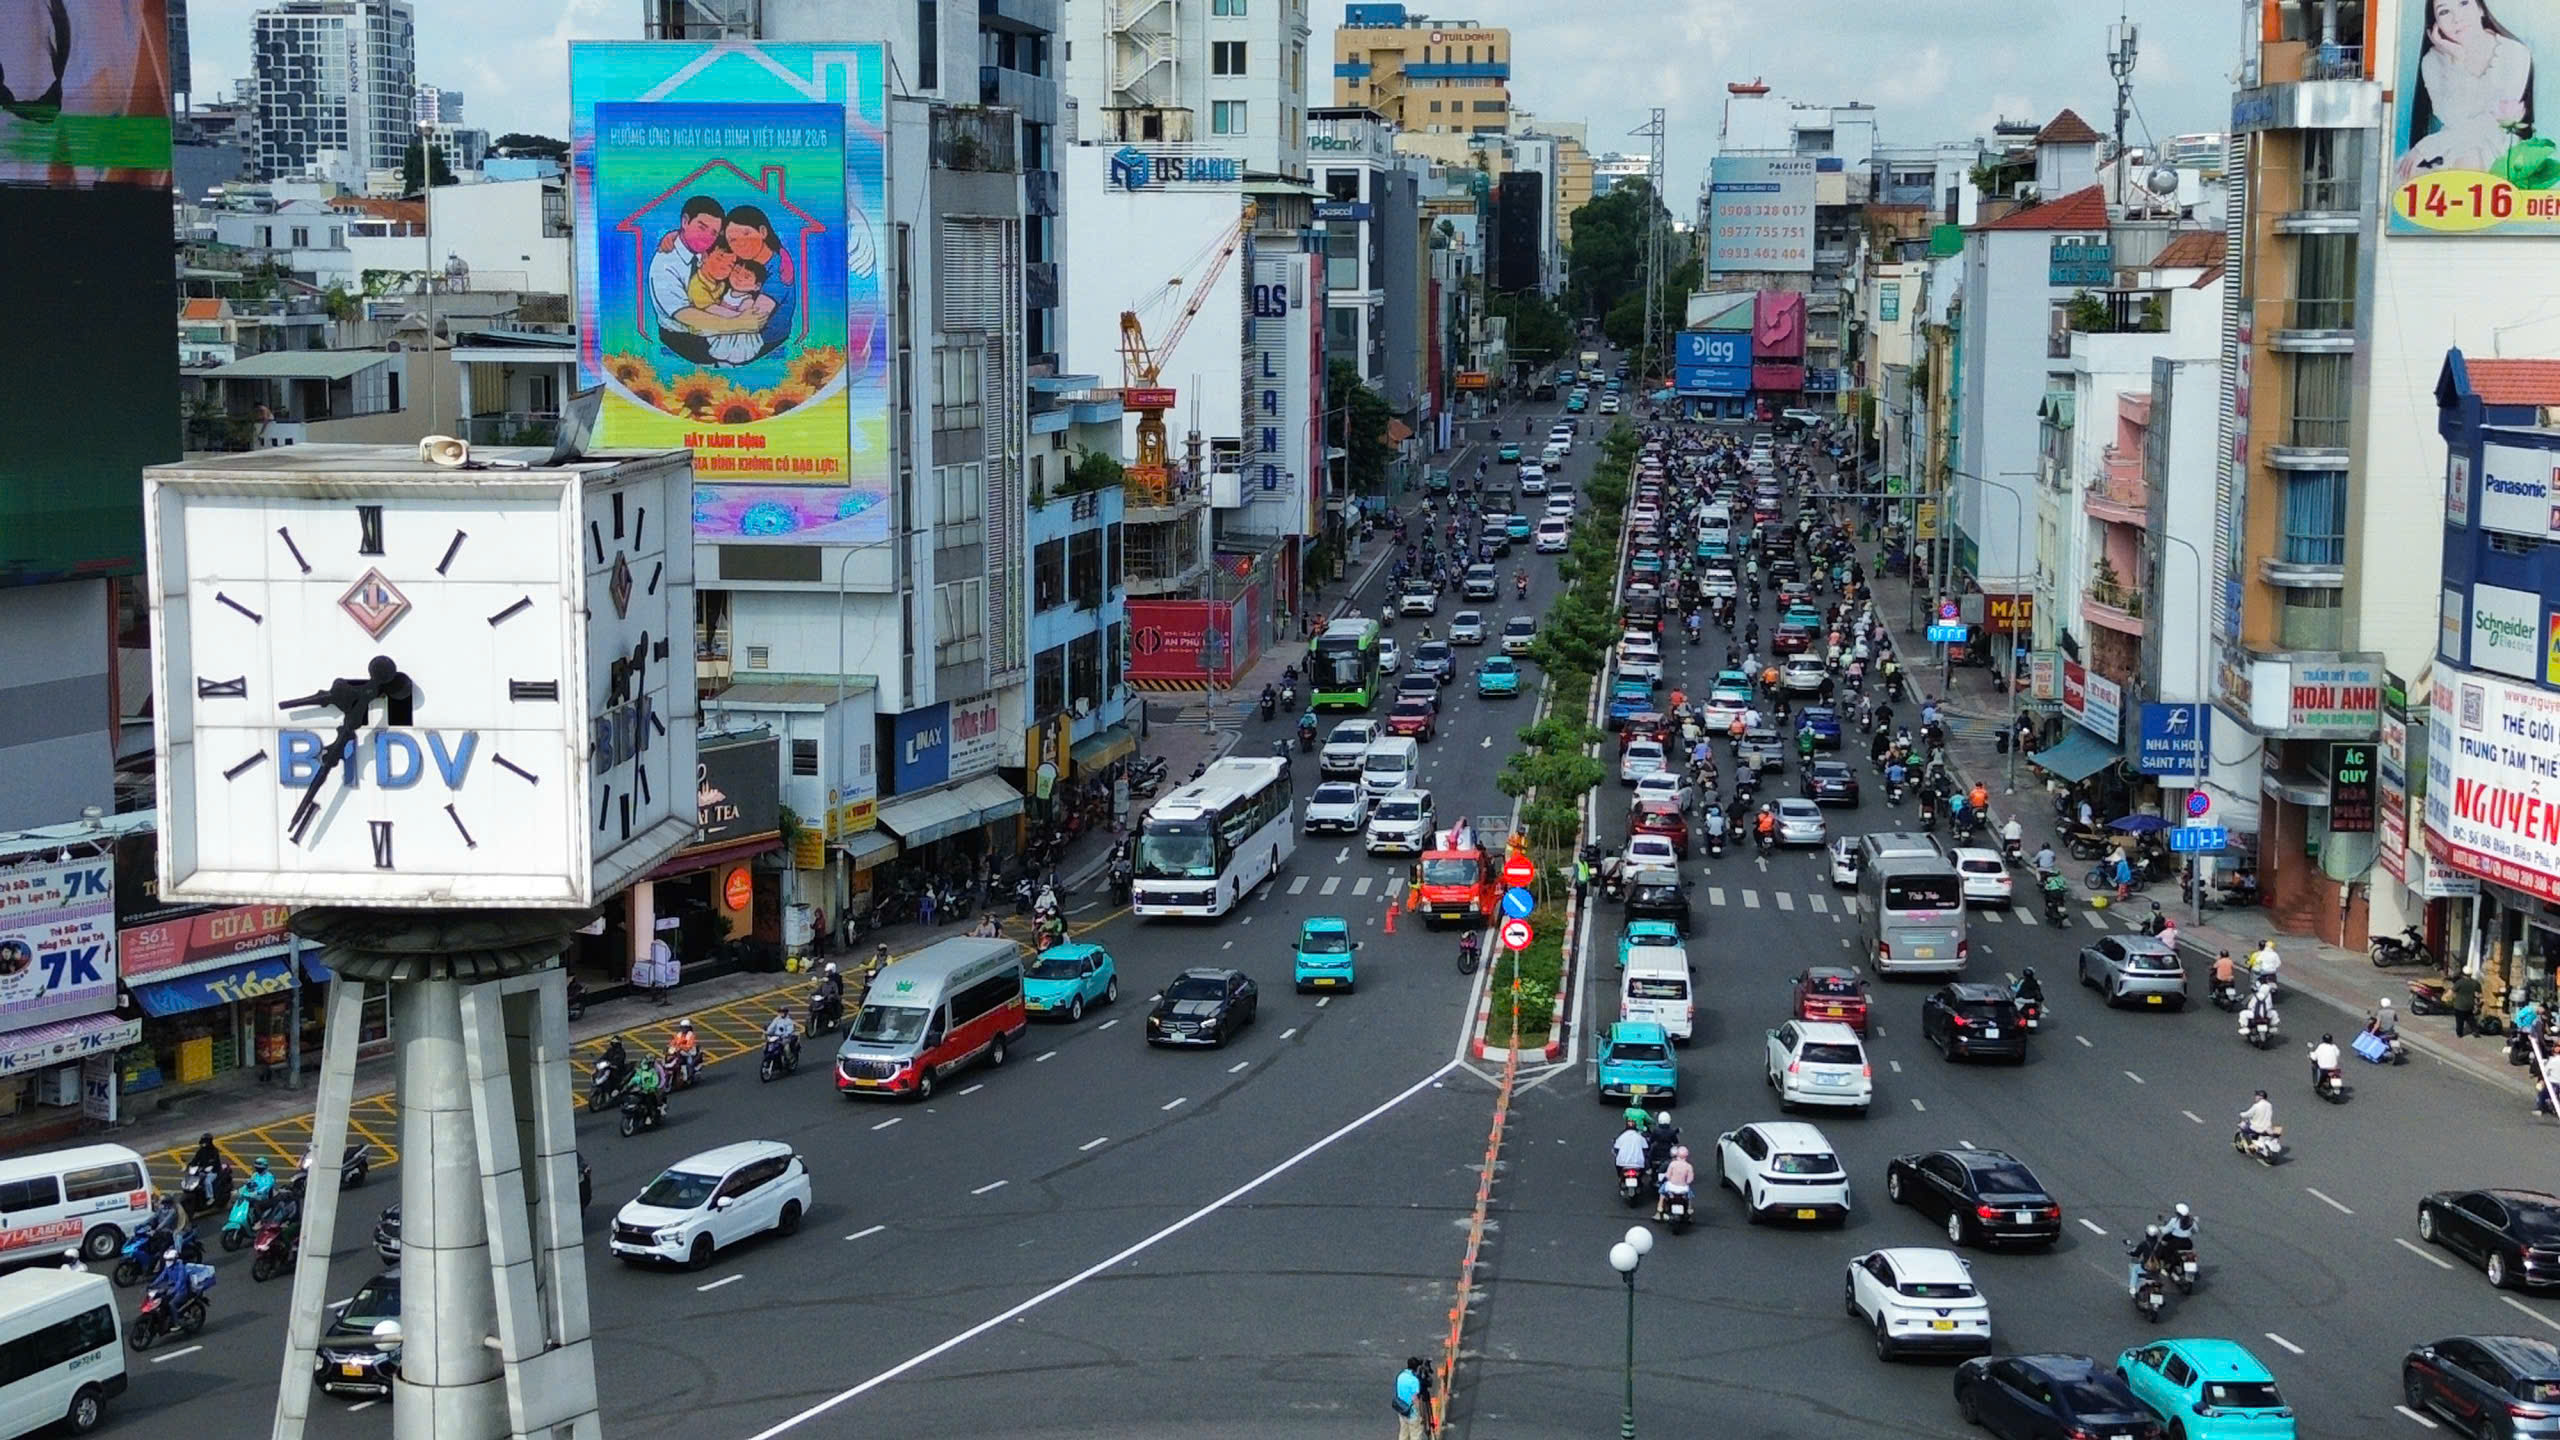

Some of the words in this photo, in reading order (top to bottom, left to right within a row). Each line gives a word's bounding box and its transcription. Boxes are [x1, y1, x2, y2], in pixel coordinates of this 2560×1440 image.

[349, 42, 360, 93] NOVOTEL
[1768, 162, 1812, 170] PACIFIC
[2403, 183, 2513, 218] 14-16
[1692, 336, 1734, 363] Diag
[2485, 473, 2547, 498] Panasonic
[2475, 609, 2536, 639] Schneider
[2293, 683, 2336, 709] HOÀI
[2342, 687, 2377, 709] ANH
[2502, 711, 2526, 736] THẾ
[916, 727, 942, 751] INAX
[2145, 738, 2170, 751] NHA
[278, 728, 480, 790] BIDV
[2141, 756, 2176, 769] SAINT
[2178, 756, 2208, 770] PAL
[2459, 735, 2497, 762] TRUNG
[2502, 744, 2527, 770] TÂM
[2531, 752, 2560, 779] THIẾ
[2339, 769, 2369, 783] QUY
[714, 804, 740, 823] TEA
[2453, 777, 2560, 847] NGUYỄN
[64, 867, 108, 898] 7K
[40, 945, 103, 990] 7K
[205, 970, 293, 1003] Tiger
[80, 1033, 103, 1050] 7K
[86, 1081, 109, 1099] 7K
[12, 1219, 82, 1243] LALAMOVE
